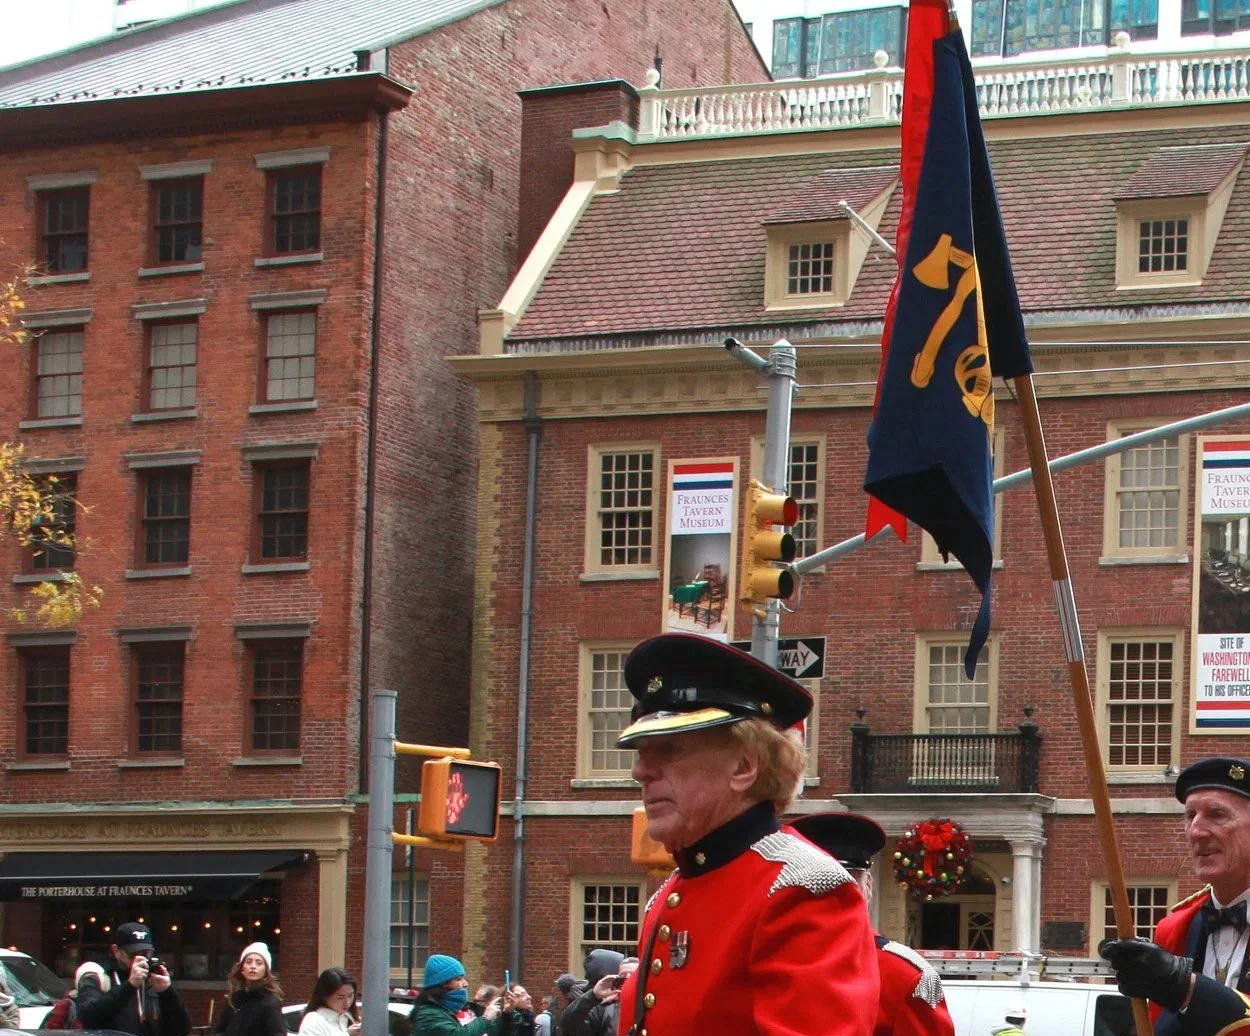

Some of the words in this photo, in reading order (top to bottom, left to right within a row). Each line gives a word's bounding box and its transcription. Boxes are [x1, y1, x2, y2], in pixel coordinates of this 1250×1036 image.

[677, 494, 729, 505] FRAUNCES
[680, 518, 724, 528] MUSEUM
[1220, 637, 1234, 649] SITE
[1236, 637, 1244, 649] OF
[781, 651, 809, 667] WAY
[1212, 668, 1250, 682] FAREWELL
[1204, 685, 1213, 696] TO
[1215, 685, 1226, 696] HIS
[21, 887, 36, 897] THE
[38, 887, 95, 897] PORTERHOUSE
[97, 886, 108, 897] AT
[109, 886, 152, 896] FRAUNCES
